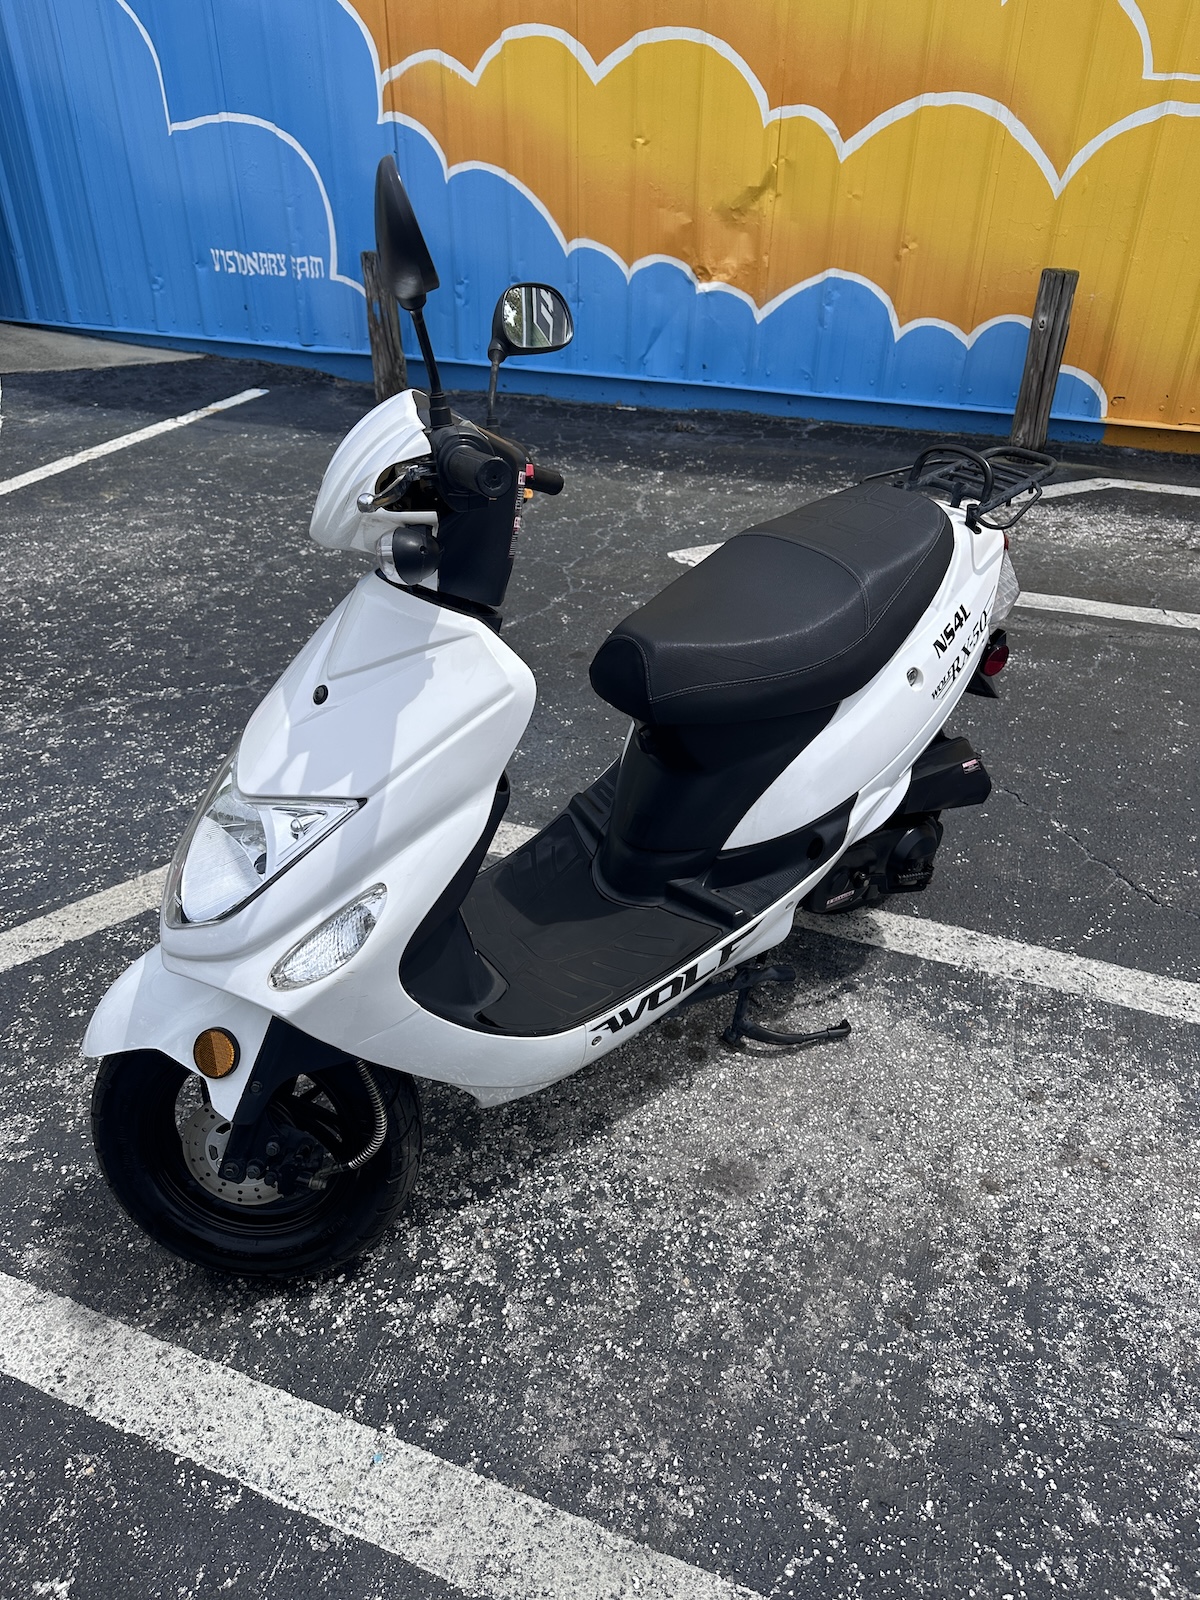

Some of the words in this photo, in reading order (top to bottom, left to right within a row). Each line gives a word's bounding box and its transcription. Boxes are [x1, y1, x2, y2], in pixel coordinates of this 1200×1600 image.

[210, 248, 287, 276] VISIONARY
[290, 255, 325, 280] FAM
[931, 667, 954, 700] WOLF
[951, 610, 988, 682] RX-50
[588, 916, 768, 1034] WOLF
